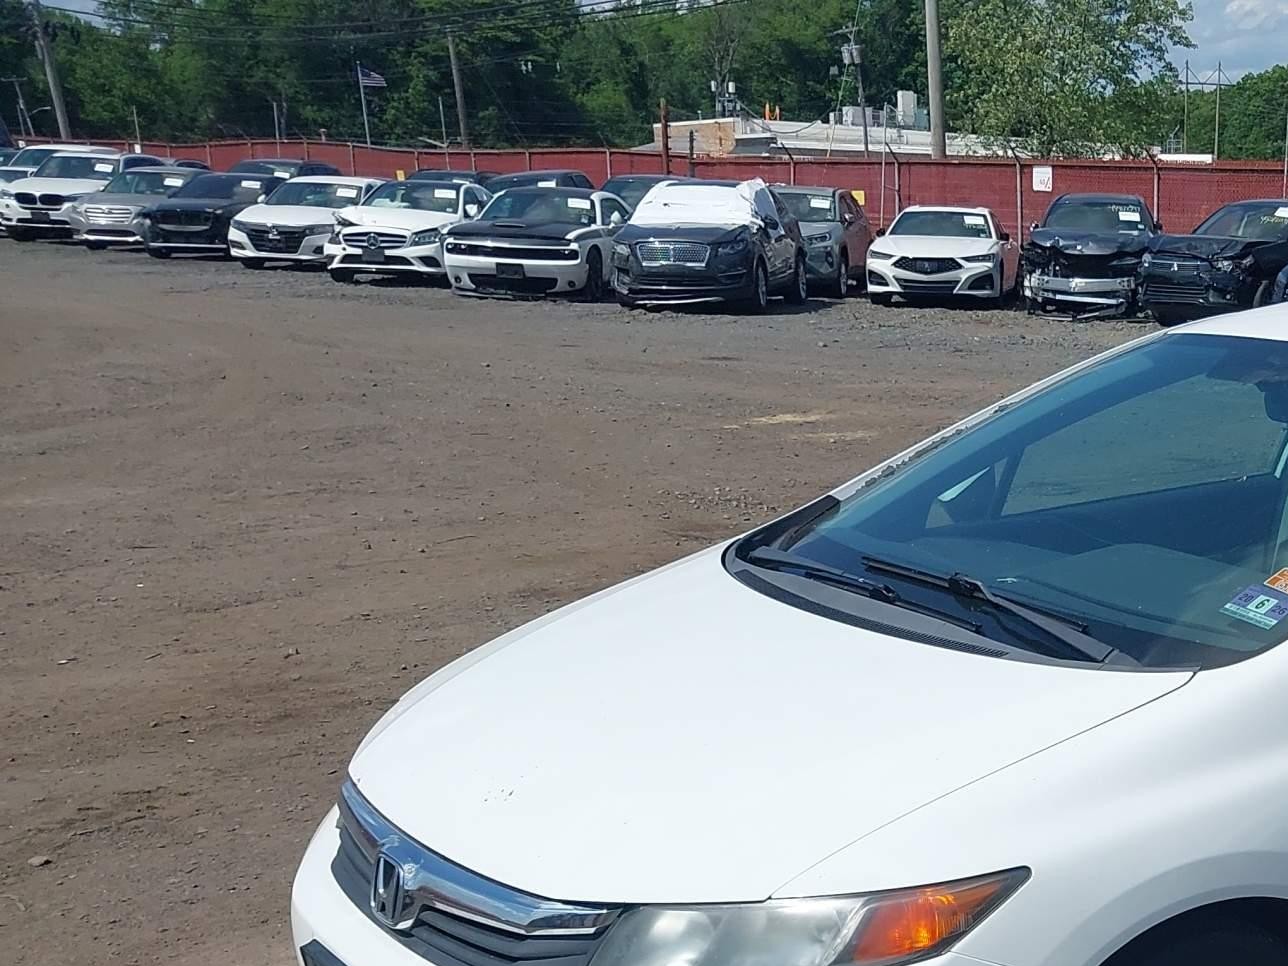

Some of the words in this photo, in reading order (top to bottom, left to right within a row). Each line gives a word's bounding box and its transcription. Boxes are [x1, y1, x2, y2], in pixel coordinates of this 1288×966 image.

[1238, 593, 1254, 603] 20
[1255, 599, 1270, 609] 6
[1271, 605, 1288, 615] 26
